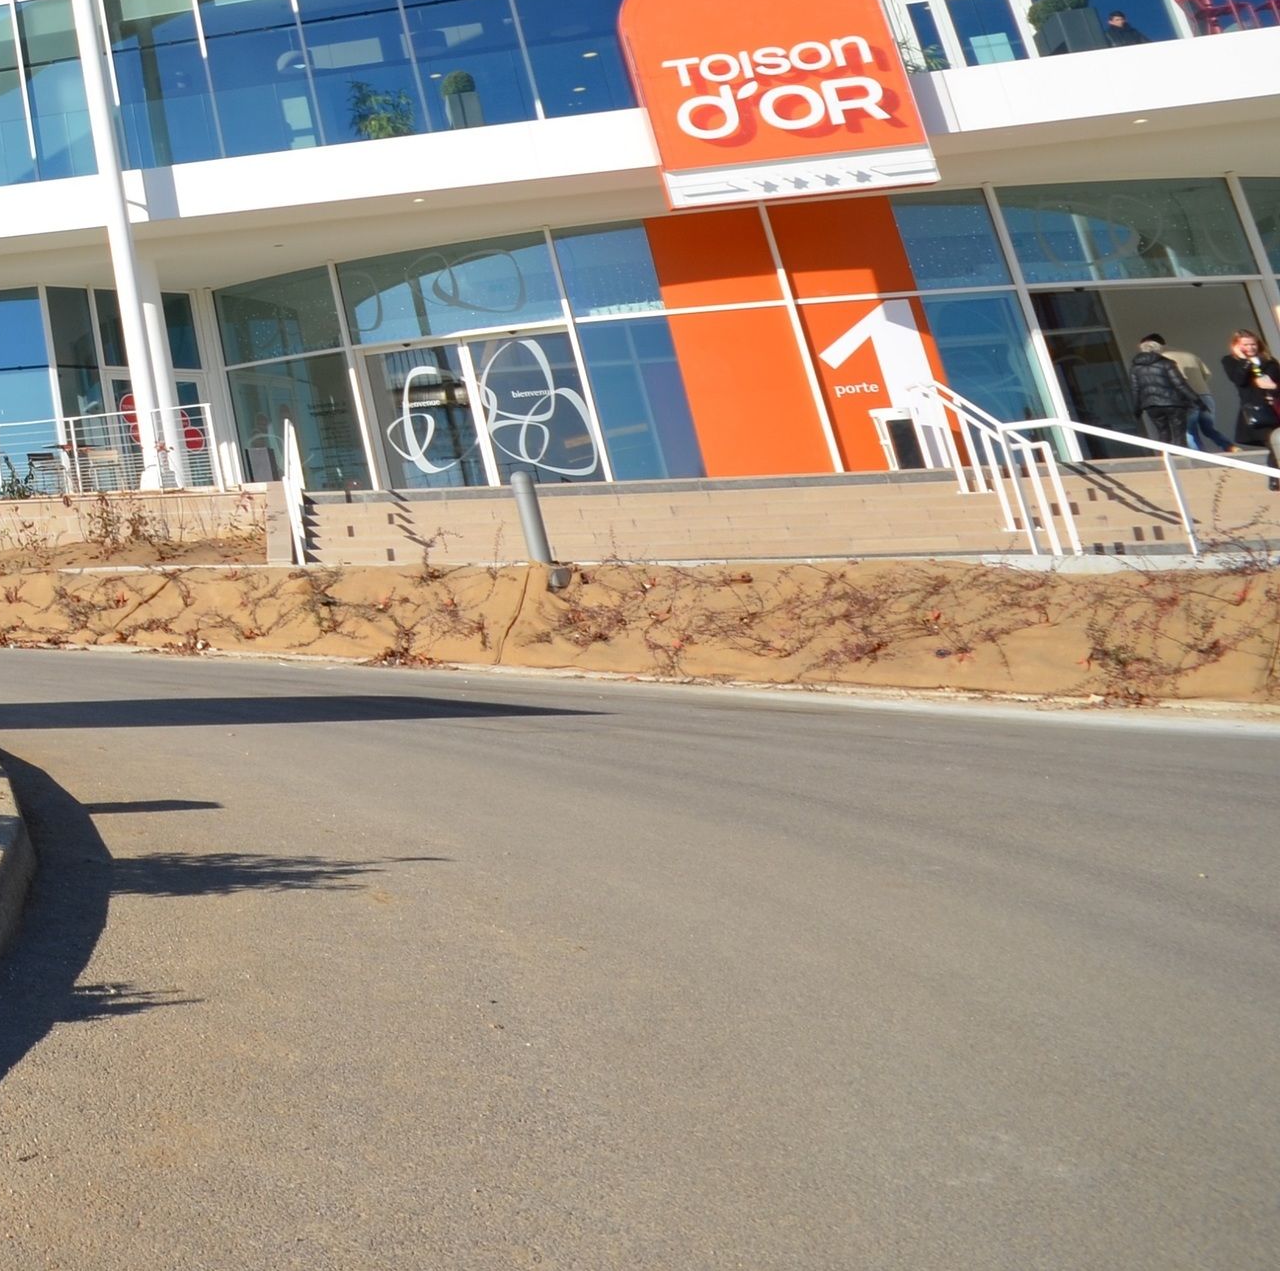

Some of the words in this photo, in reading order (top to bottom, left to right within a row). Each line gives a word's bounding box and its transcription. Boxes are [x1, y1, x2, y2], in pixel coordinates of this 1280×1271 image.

[819, 299, 953, 468] 1
[834, 381, 880, 398] porte
[511, 388, 556, 399] bienvenu
